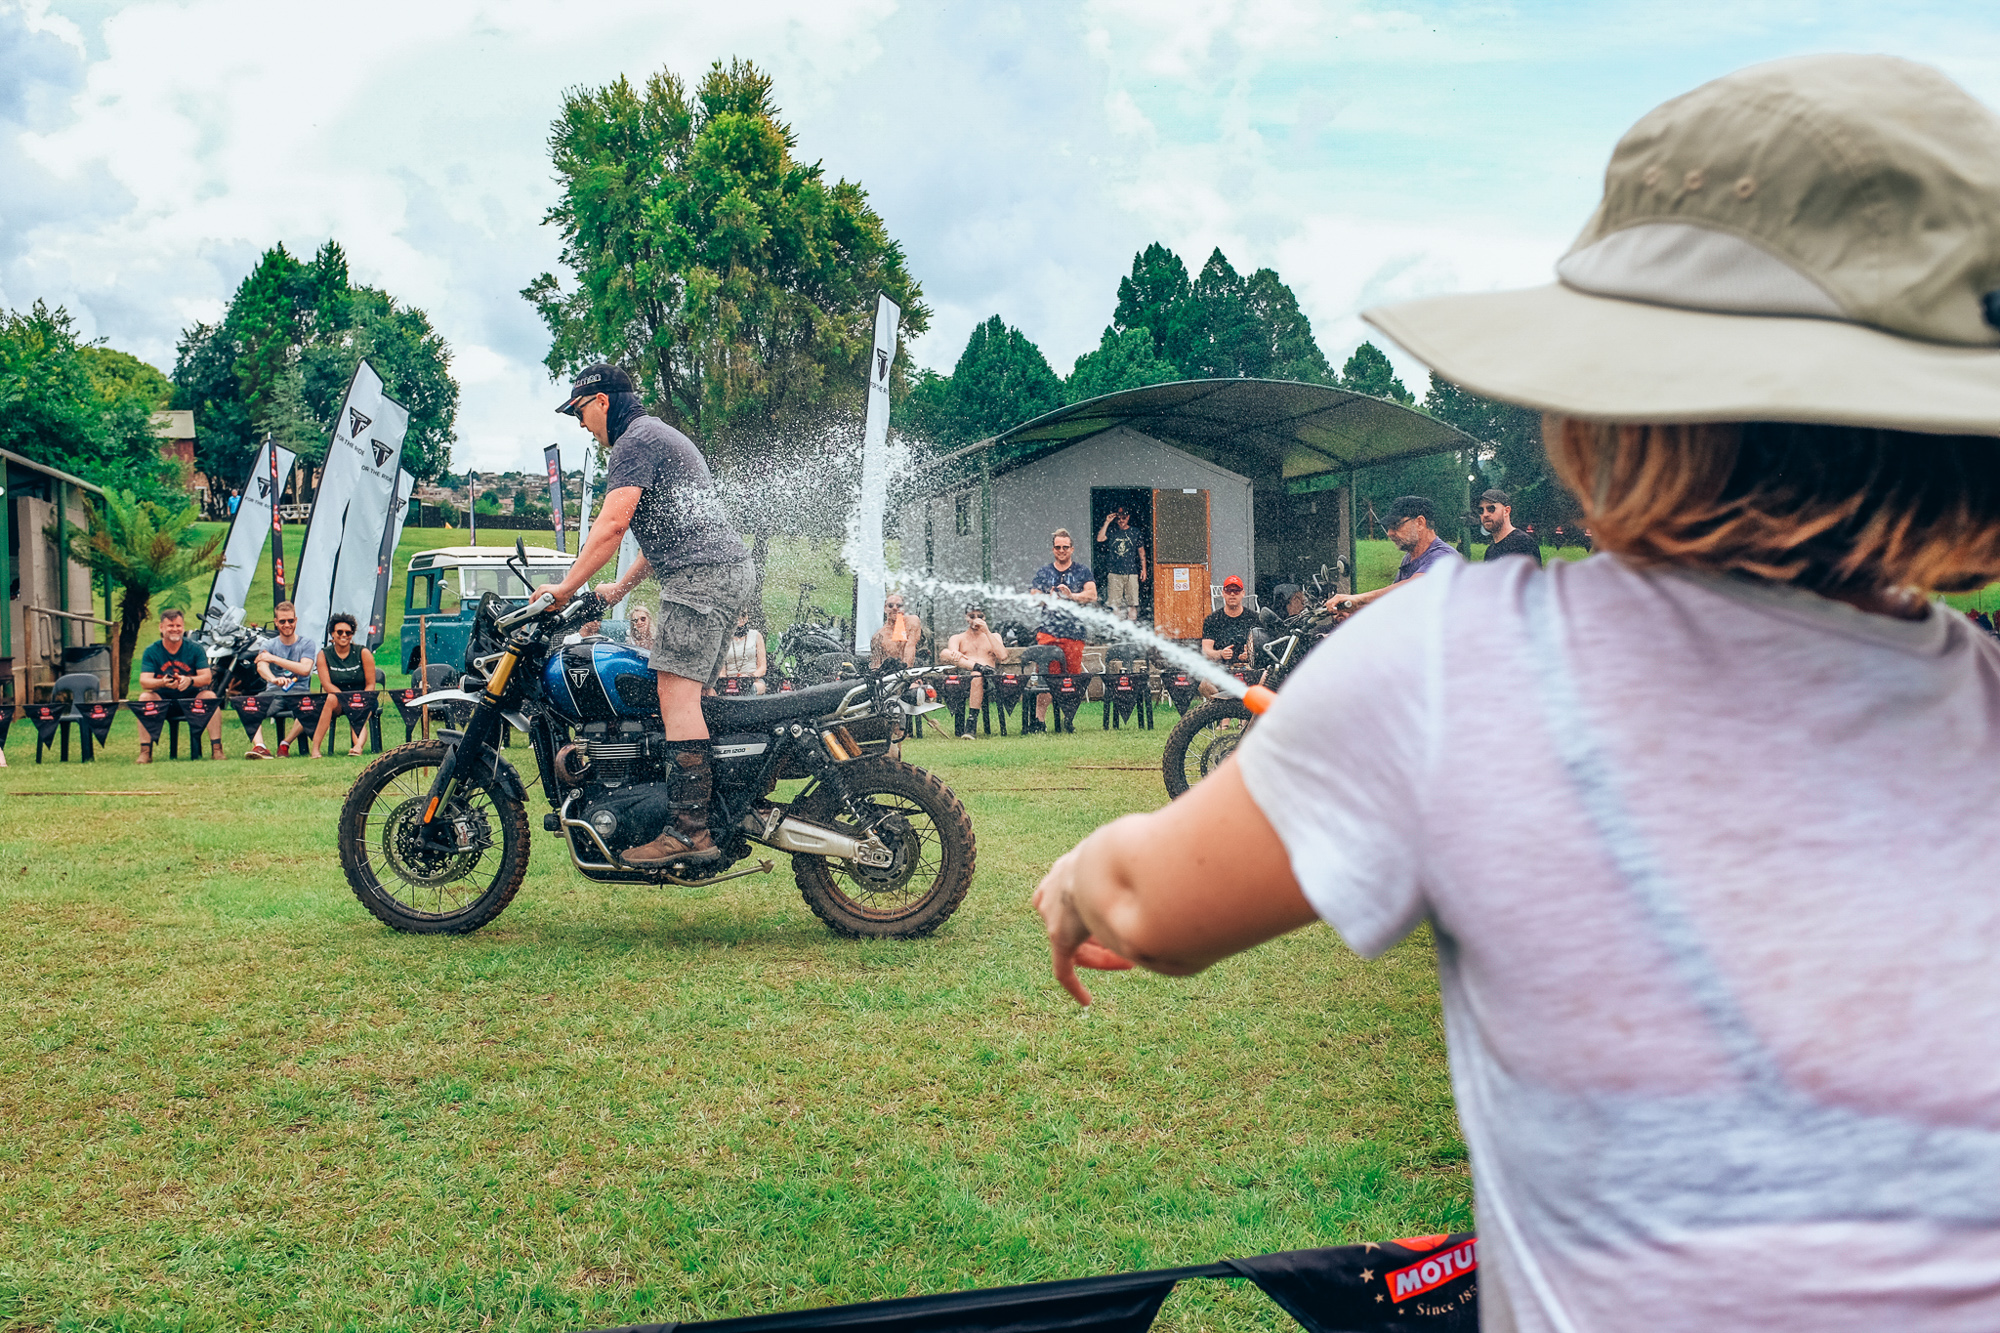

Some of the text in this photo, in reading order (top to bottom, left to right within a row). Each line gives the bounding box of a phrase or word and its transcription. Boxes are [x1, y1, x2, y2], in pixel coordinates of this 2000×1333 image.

[336, 433, 345, 442] FOR
[344, 438, 354, 449] THE
[354, 445, 365, 456] RIDE
[370, 468, 380, 478] THE
[1416, 1284, 1477, 1316] Since 185
